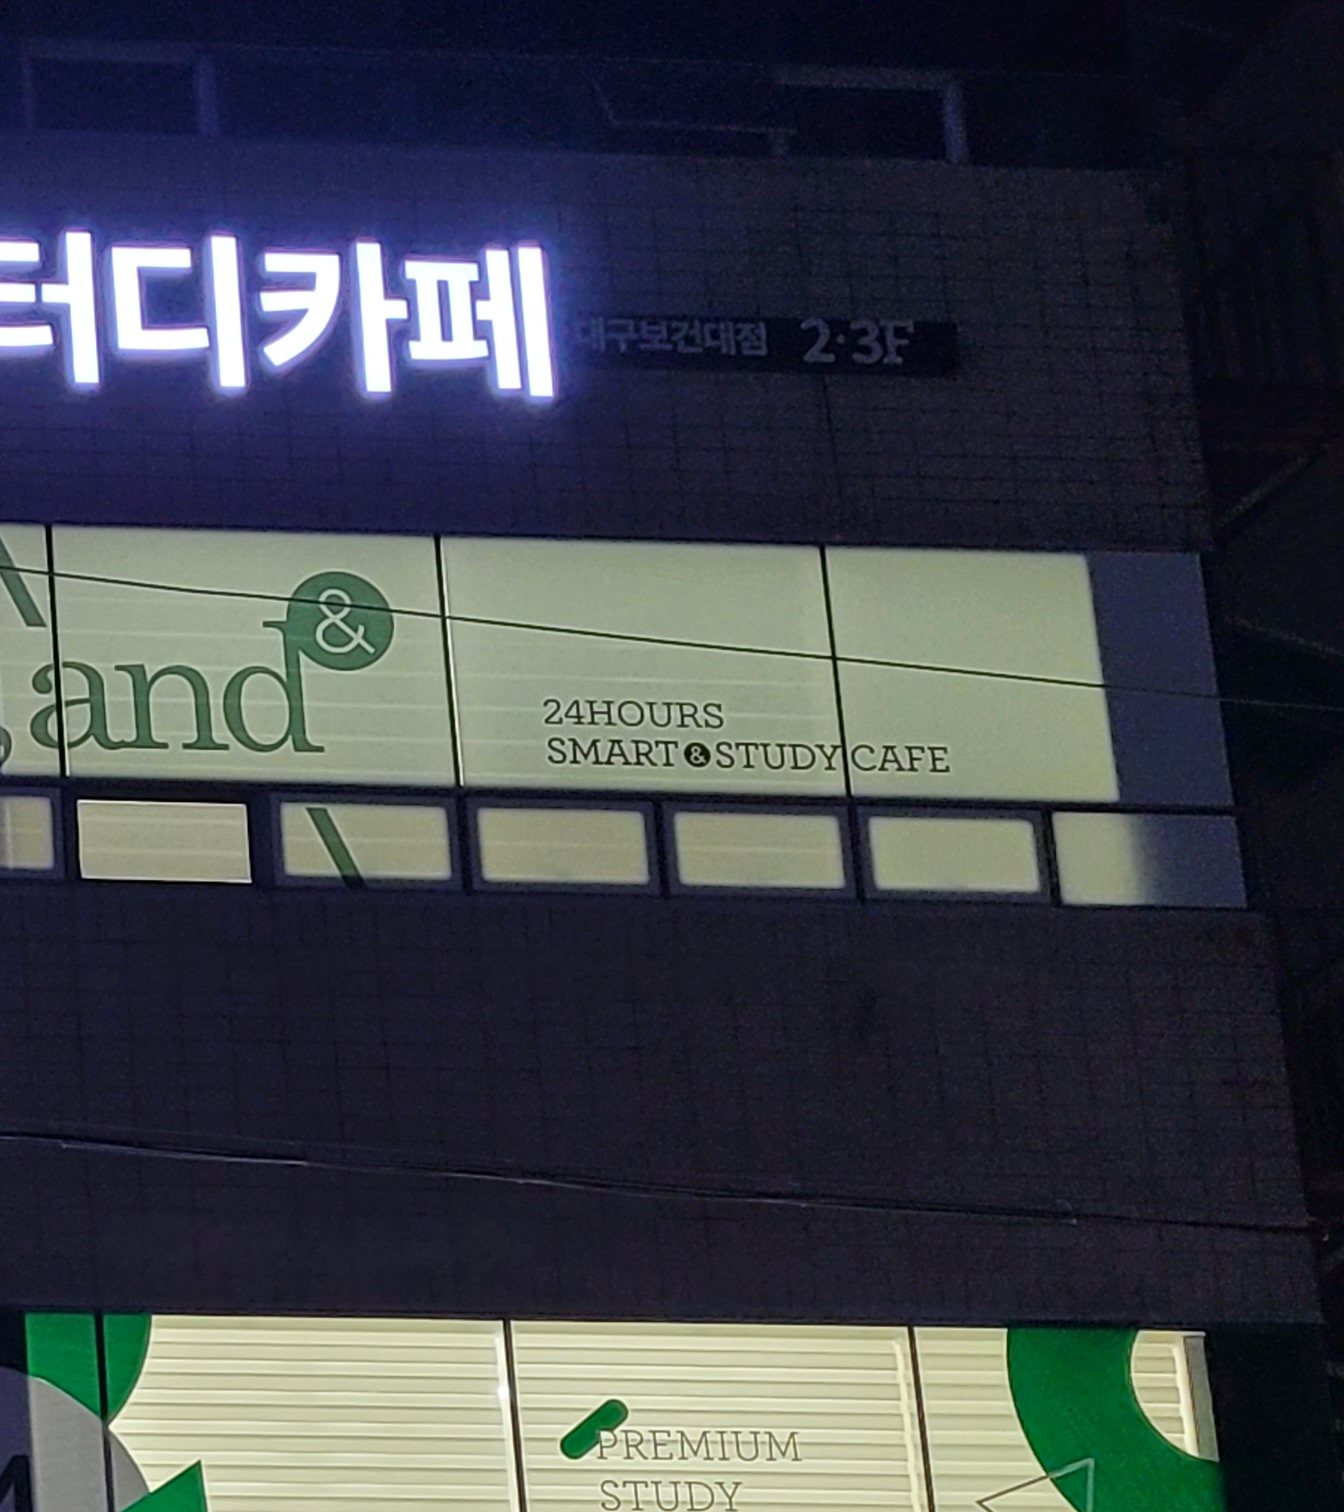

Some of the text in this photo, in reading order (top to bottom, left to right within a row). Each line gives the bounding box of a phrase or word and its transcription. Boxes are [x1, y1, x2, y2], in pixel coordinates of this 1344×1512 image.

[574, 316, 769, 356] 대구보건대점
[542, 698, 725, 730] 24HOURS
[850, 745, 951, 774] CAFE
[596, 1429, 803, 1462] PREMIUM
[600, 1479, 743, 1512] STUDY
